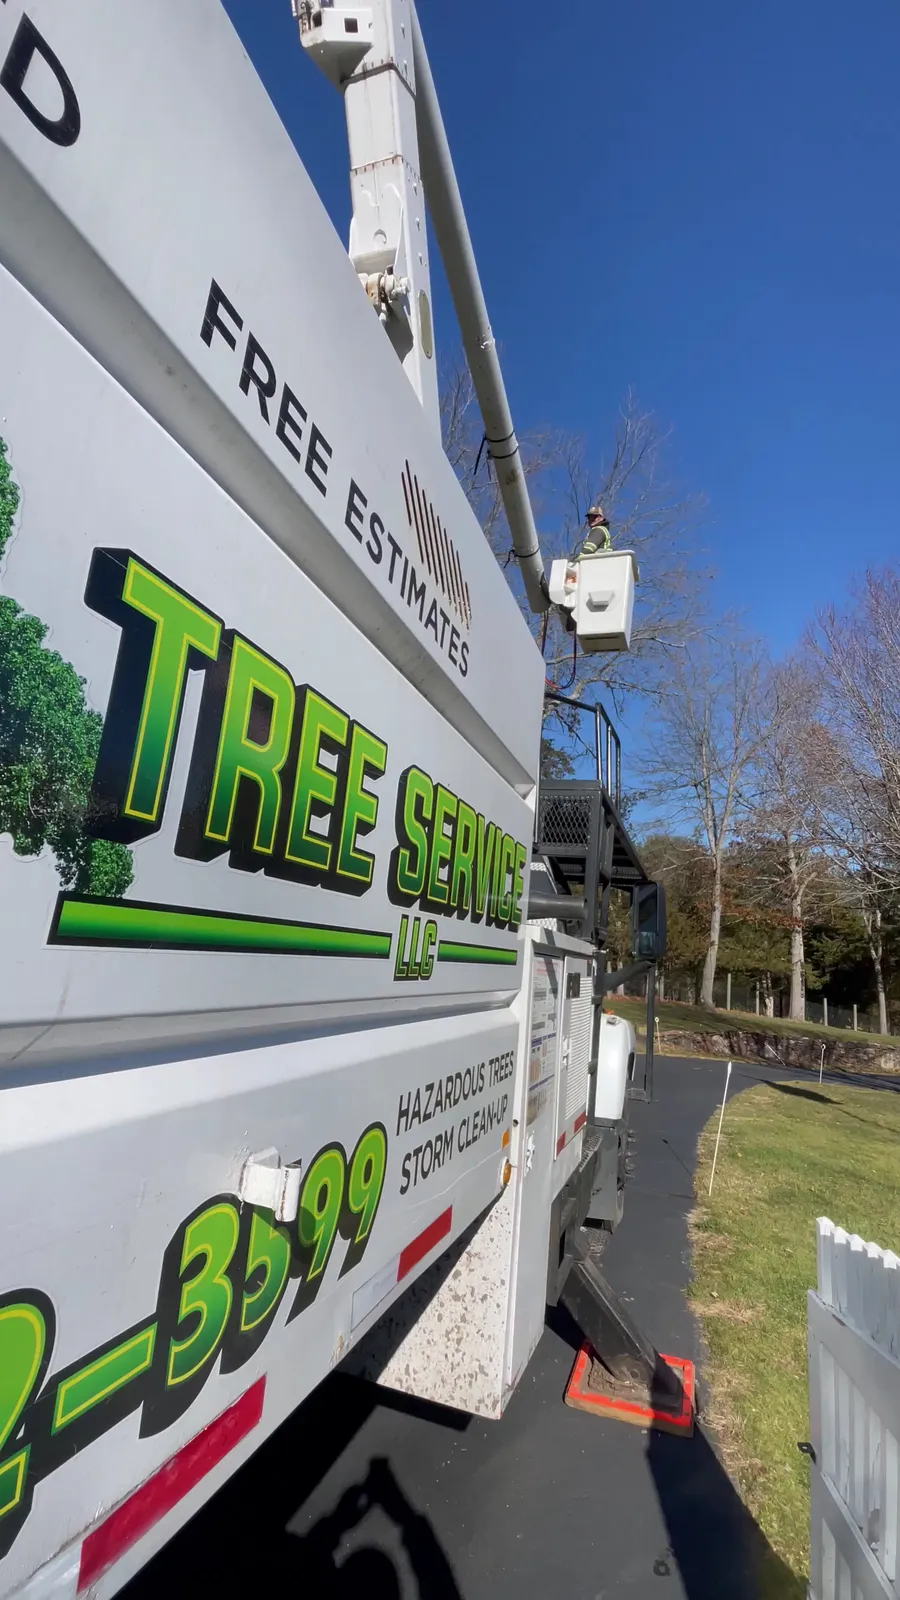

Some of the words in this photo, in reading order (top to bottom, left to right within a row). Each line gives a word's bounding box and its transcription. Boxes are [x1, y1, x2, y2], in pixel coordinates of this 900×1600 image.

[200, 277, 332, 498] FREE
[344, 477, 469, 678] ESTIMATES
[88, 548, 388, 897] TREE
[388, 765, 526, 932] SERVICE
[394, 914, 437, 981] LLC
[396, 1062, 485, 1137] HAZARDOUS
[488, 1050, 514, 1088] TREES
[399, 1125, 454, 1195] STORM
[457, 1093, 508, 1153] CLEAN-UP
